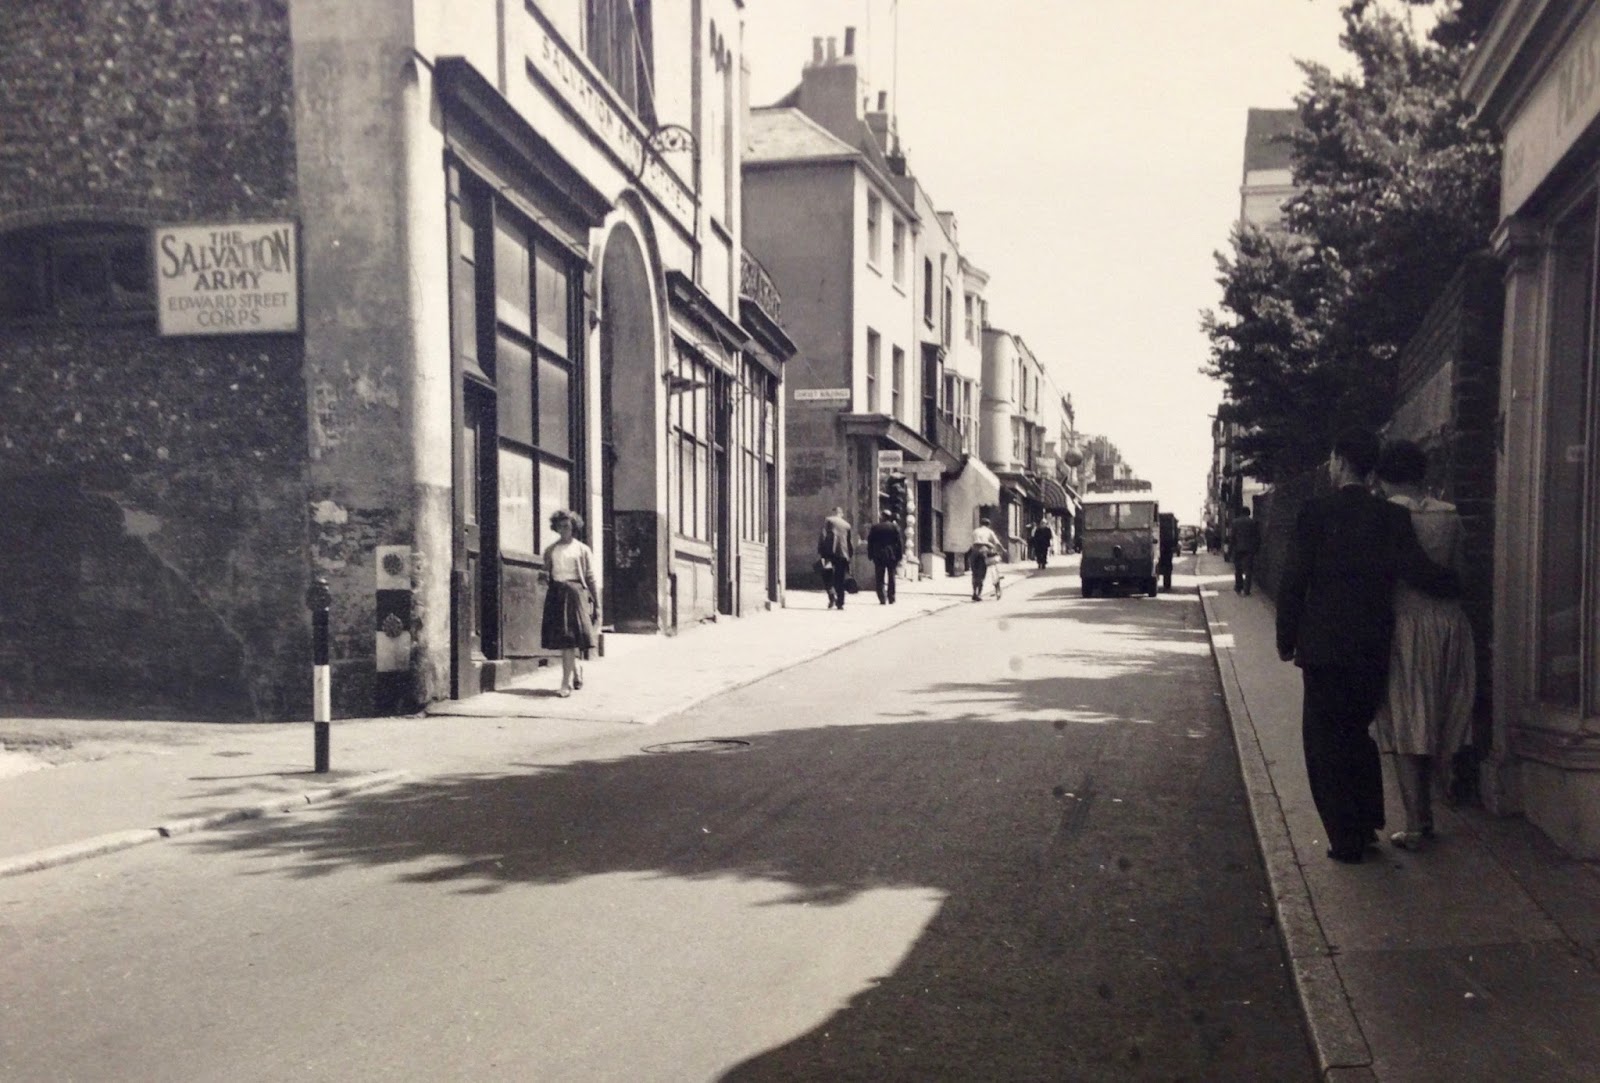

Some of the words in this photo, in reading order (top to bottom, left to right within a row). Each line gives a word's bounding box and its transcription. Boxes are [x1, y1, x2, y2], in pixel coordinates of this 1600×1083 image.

[543, 35, 613, 127] SALVATION
[209, 231, 243, 245] THE
[161, 229, 291, 278] SALVATION
[194, 270, 262, 291] ARMY
[168, 294, 237, 311] EDWARD
[238, 292, 289, 310] STREET
[197, 309, 260, 327] CORPS
